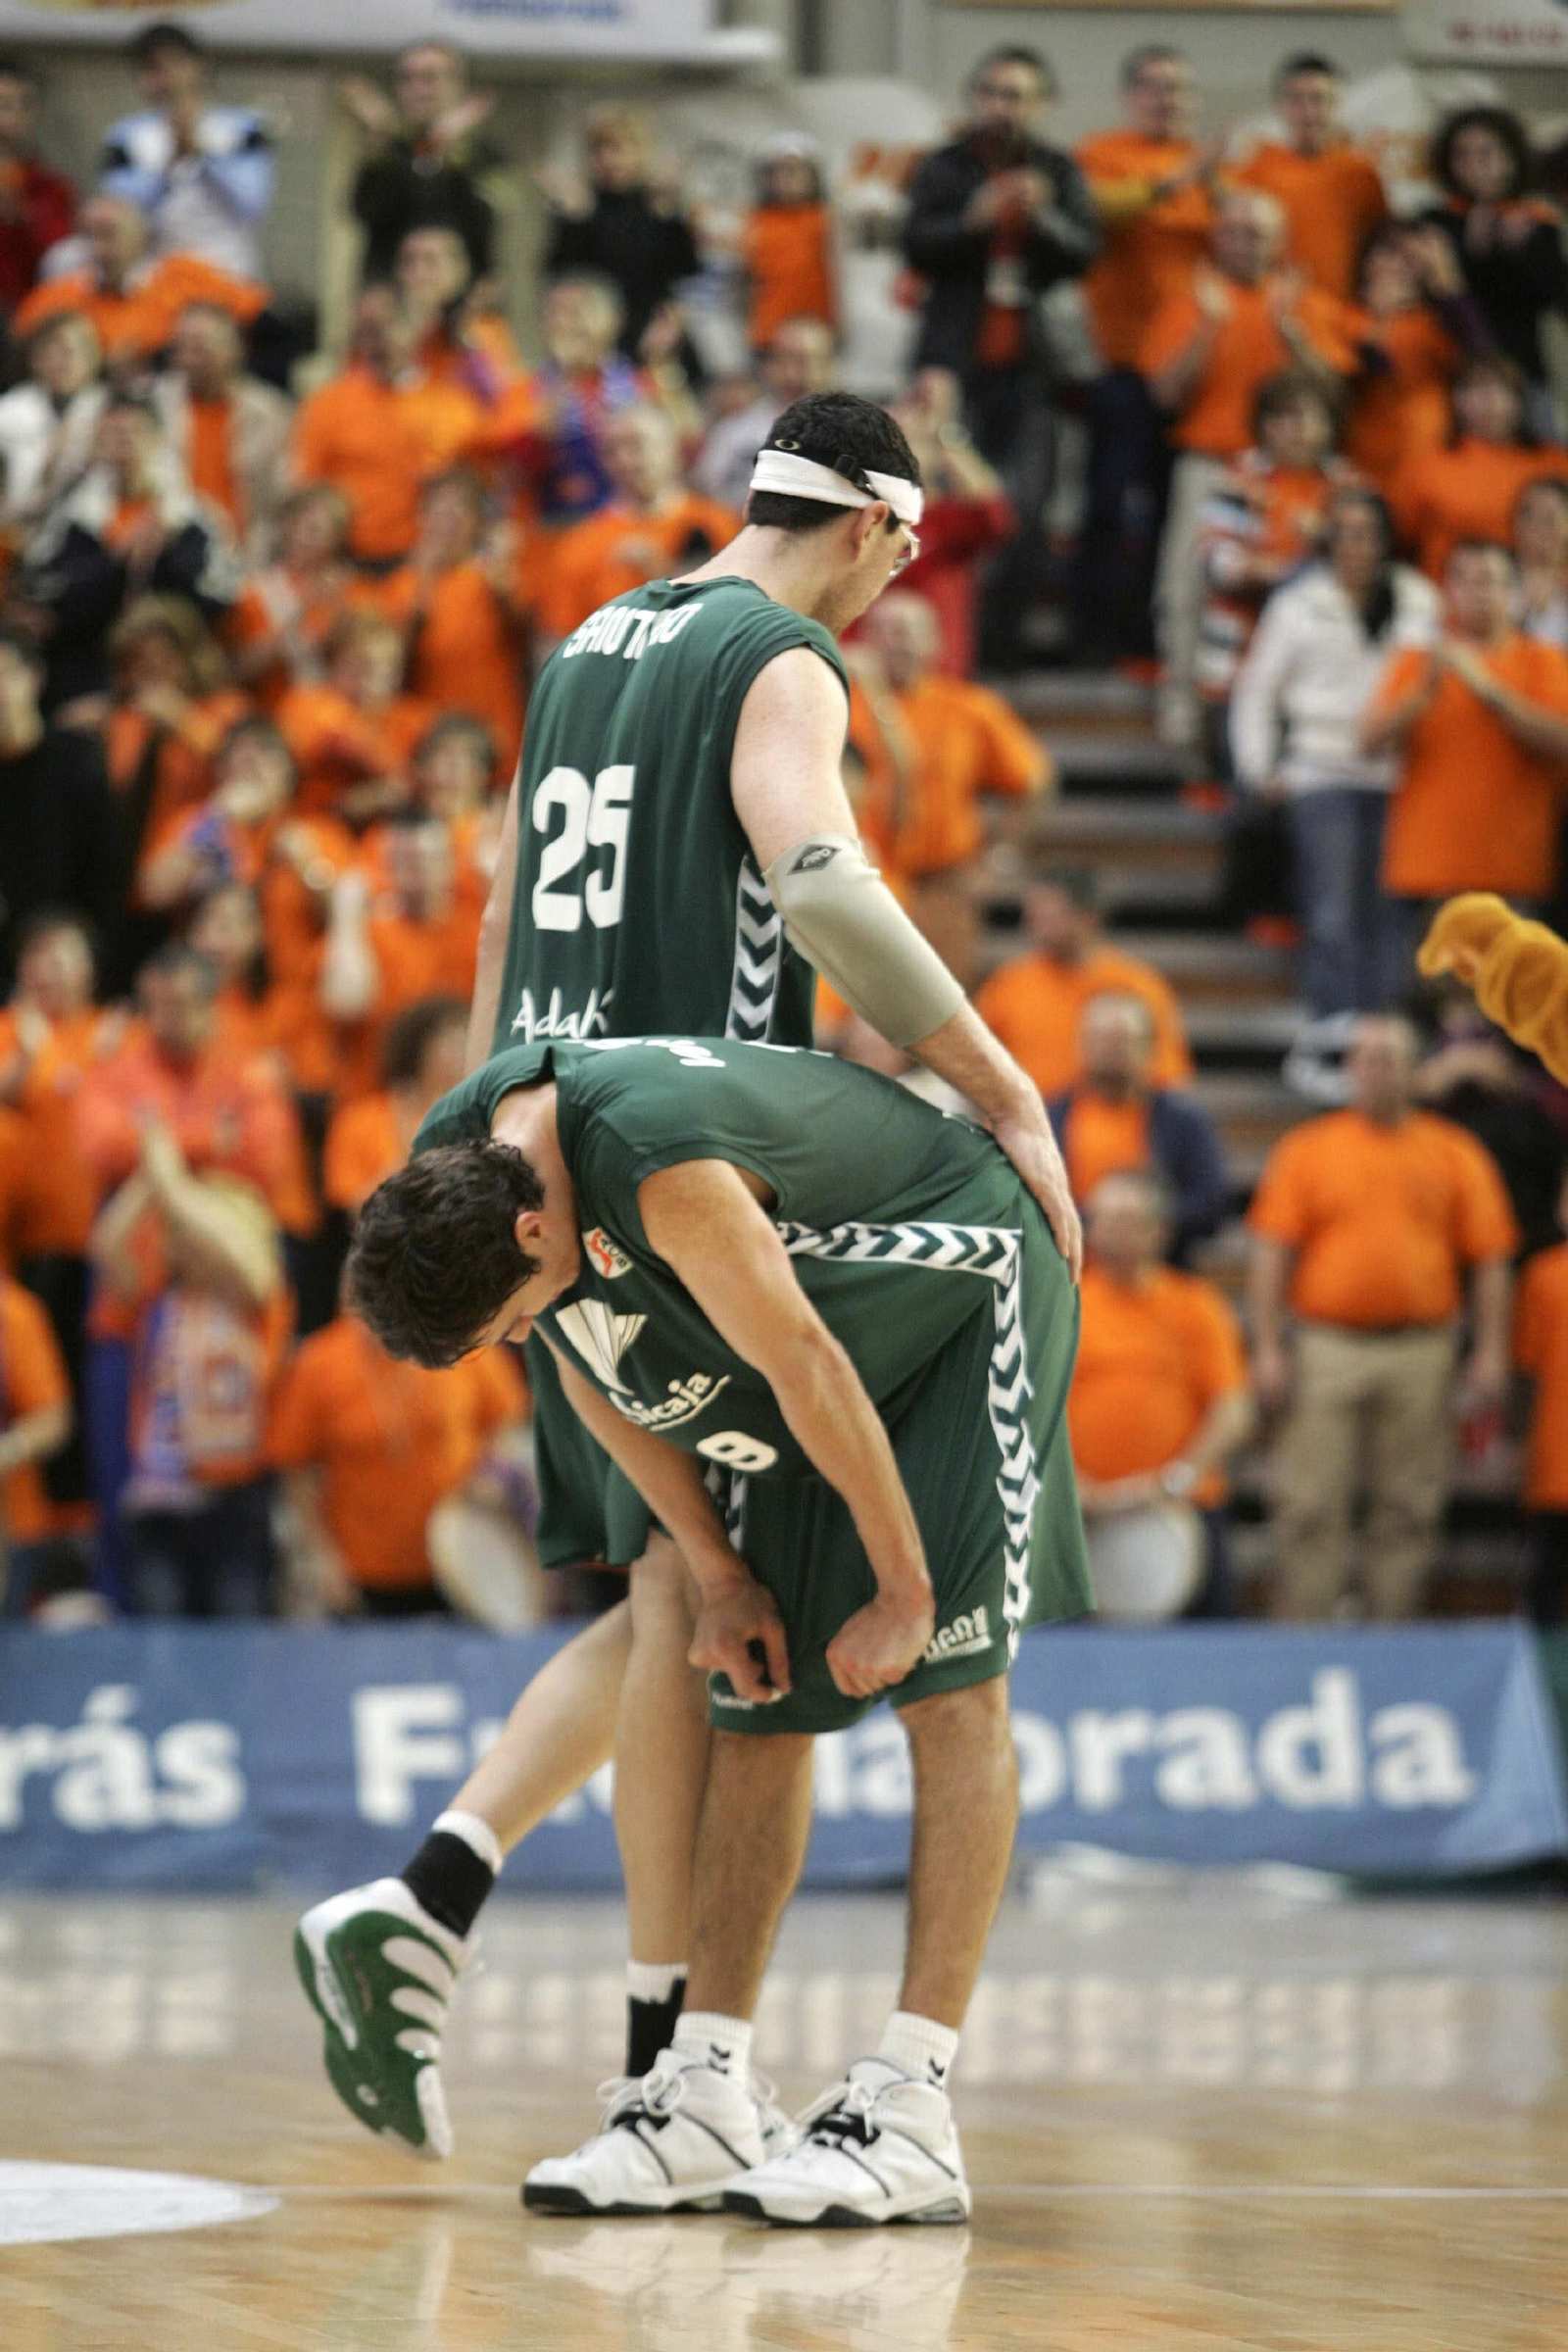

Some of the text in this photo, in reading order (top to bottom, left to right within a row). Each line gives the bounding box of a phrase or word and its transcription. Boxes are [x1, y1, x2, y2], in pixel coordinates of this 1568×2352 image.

[531, 763, 636, 933] 25
[695, 1430, 779, 1472] 8
[0, 1683, 246, 1833] rás
